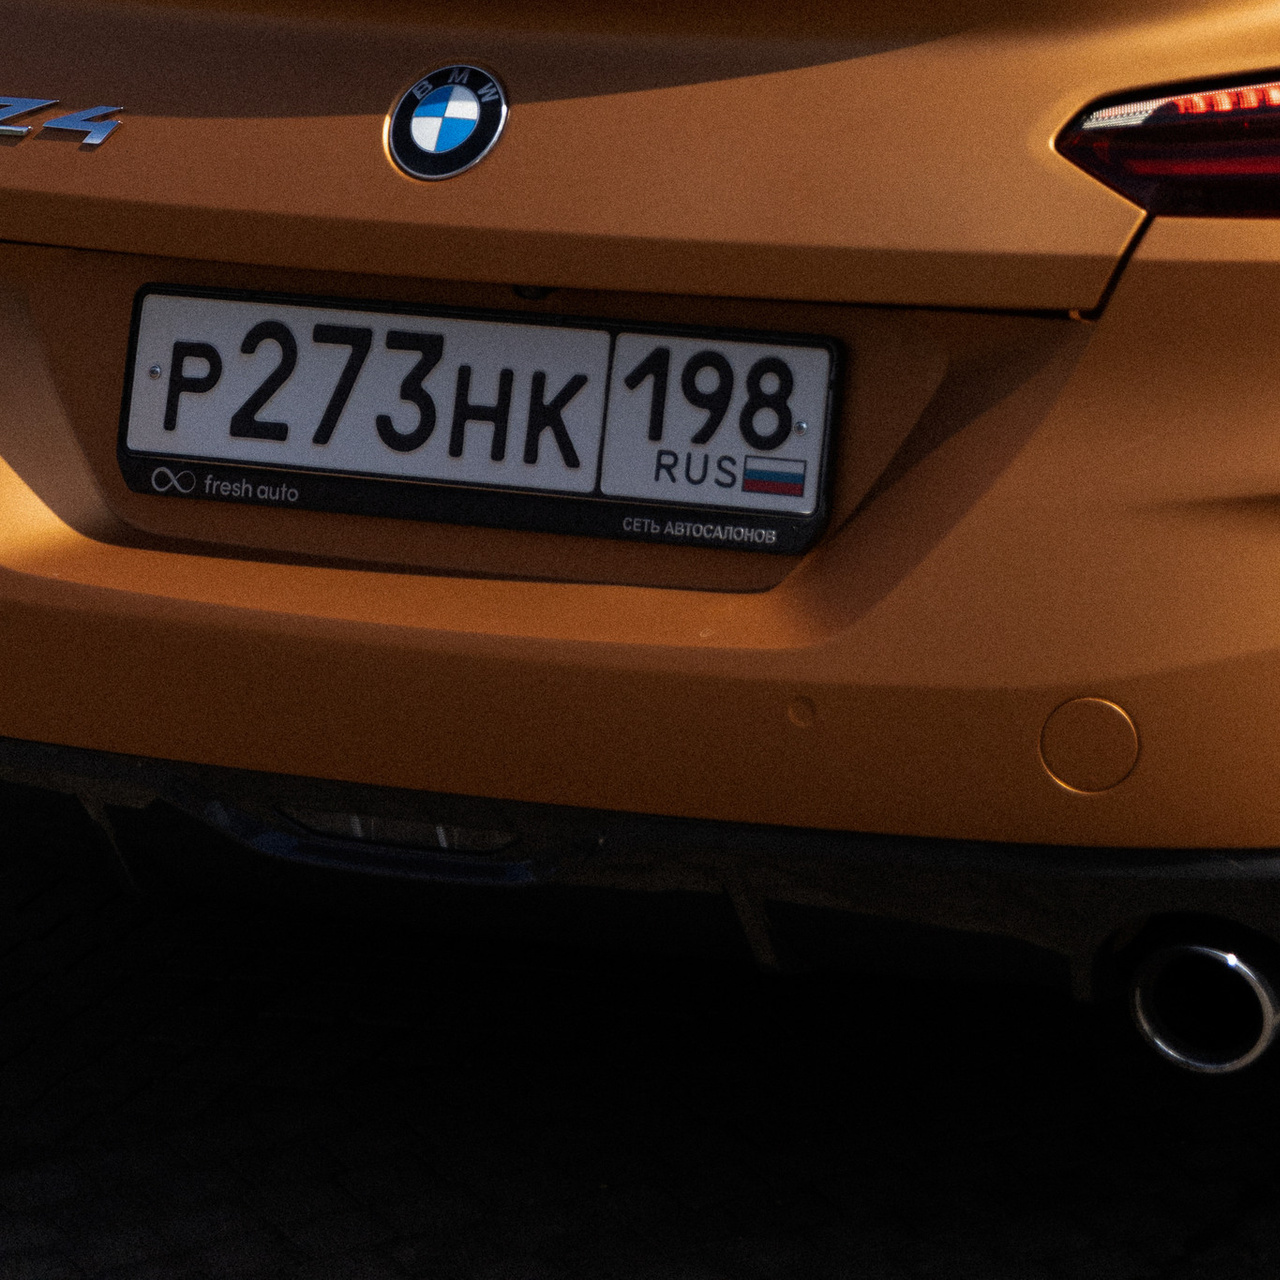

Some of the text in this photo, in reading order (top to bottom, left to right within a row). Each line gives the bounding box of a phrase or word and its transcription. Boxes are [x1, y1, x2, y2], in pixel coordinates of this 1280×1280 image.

[412, 68, 500, 102] BMW
[624, 347, 795, 450] 198
[654, 450, 736, 488] RUS
[204, 474, 299, 502] fresh auto
[622, 517, 777, 544] СЕТЬ АВТОСАЛОНОВ
